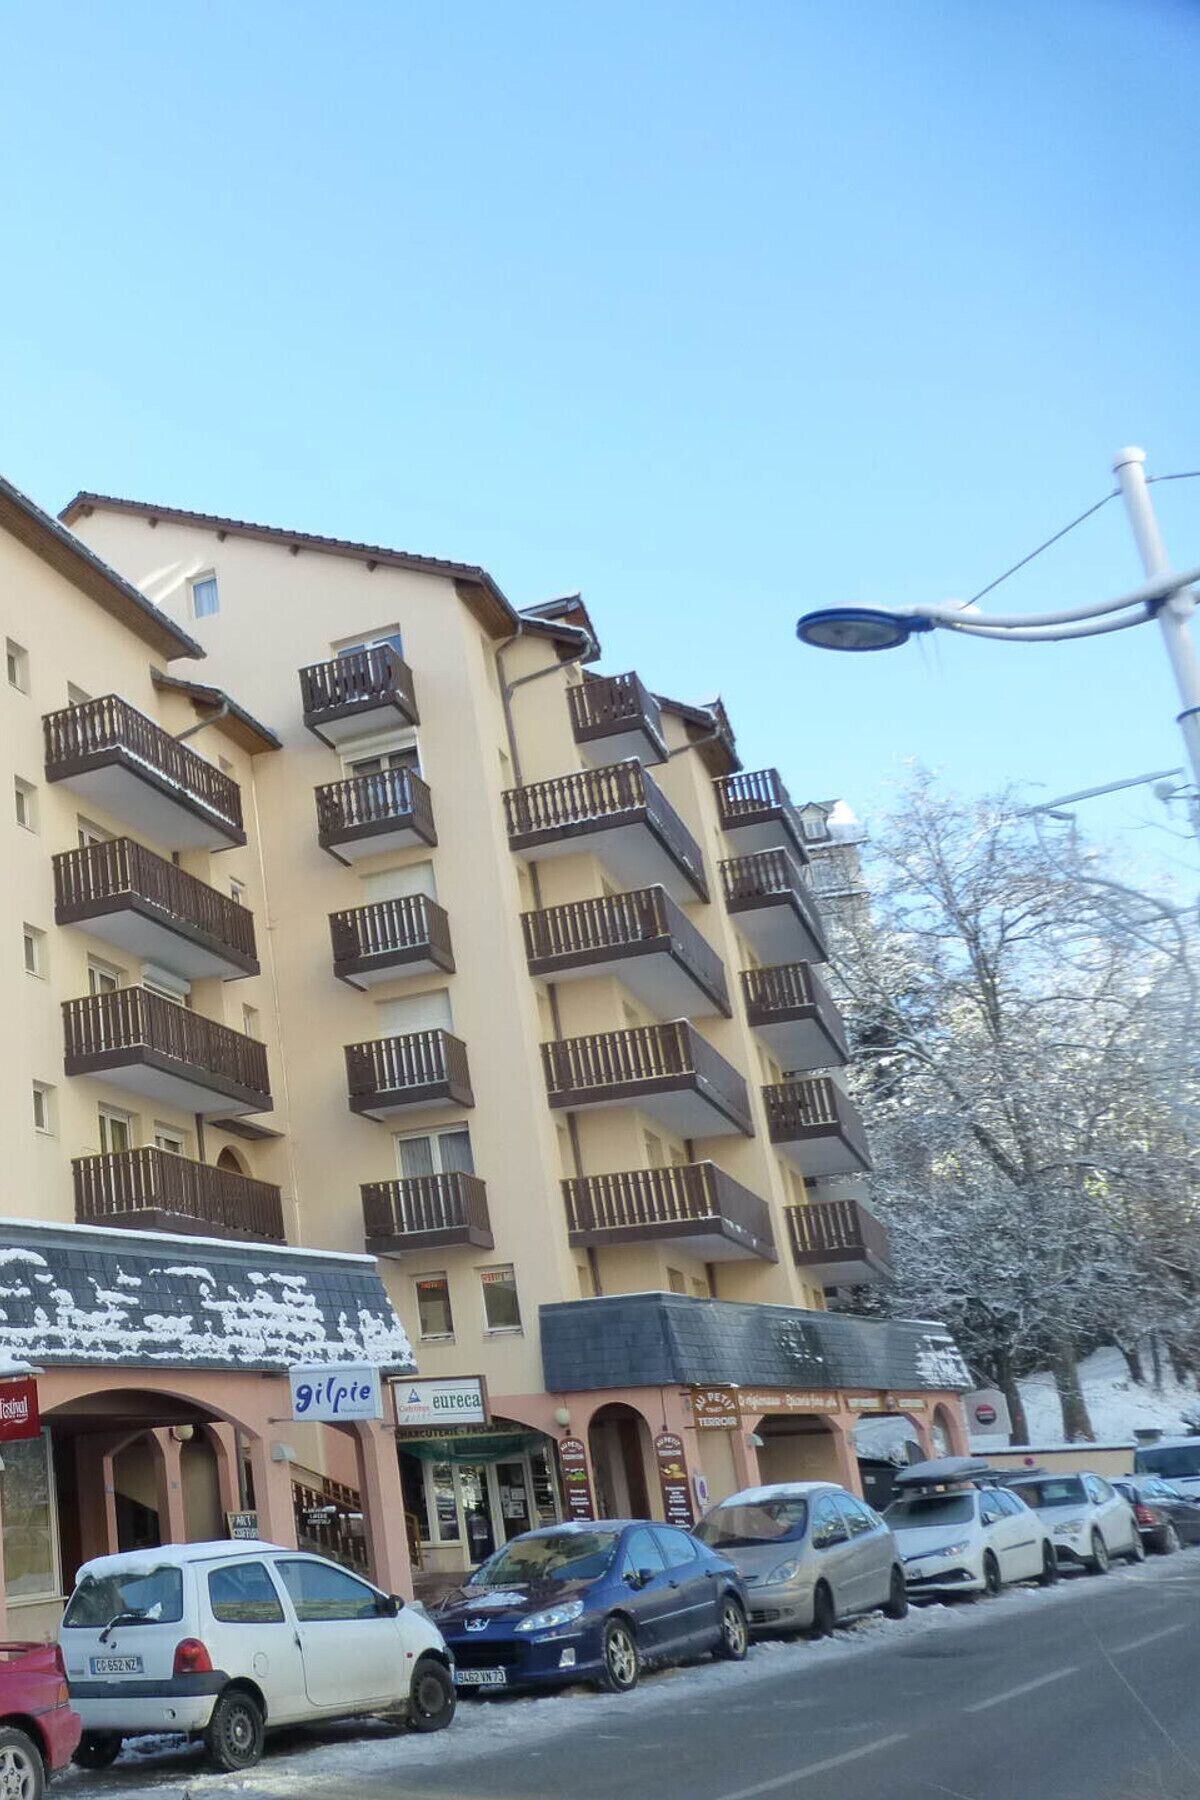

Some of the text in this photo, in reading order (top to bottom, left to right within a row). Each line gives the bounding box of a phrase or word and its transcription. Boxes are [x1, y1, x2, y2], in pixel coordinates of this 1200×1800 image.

[296, 1377, 371, 1413] gilpie
[432, 1394, 481, 1409] eureca
[696, 1395, 705, 1410] AU
[708, 1392, 736, 1410] PETIT
[698, 1416, 737, 1426] TERROIR
